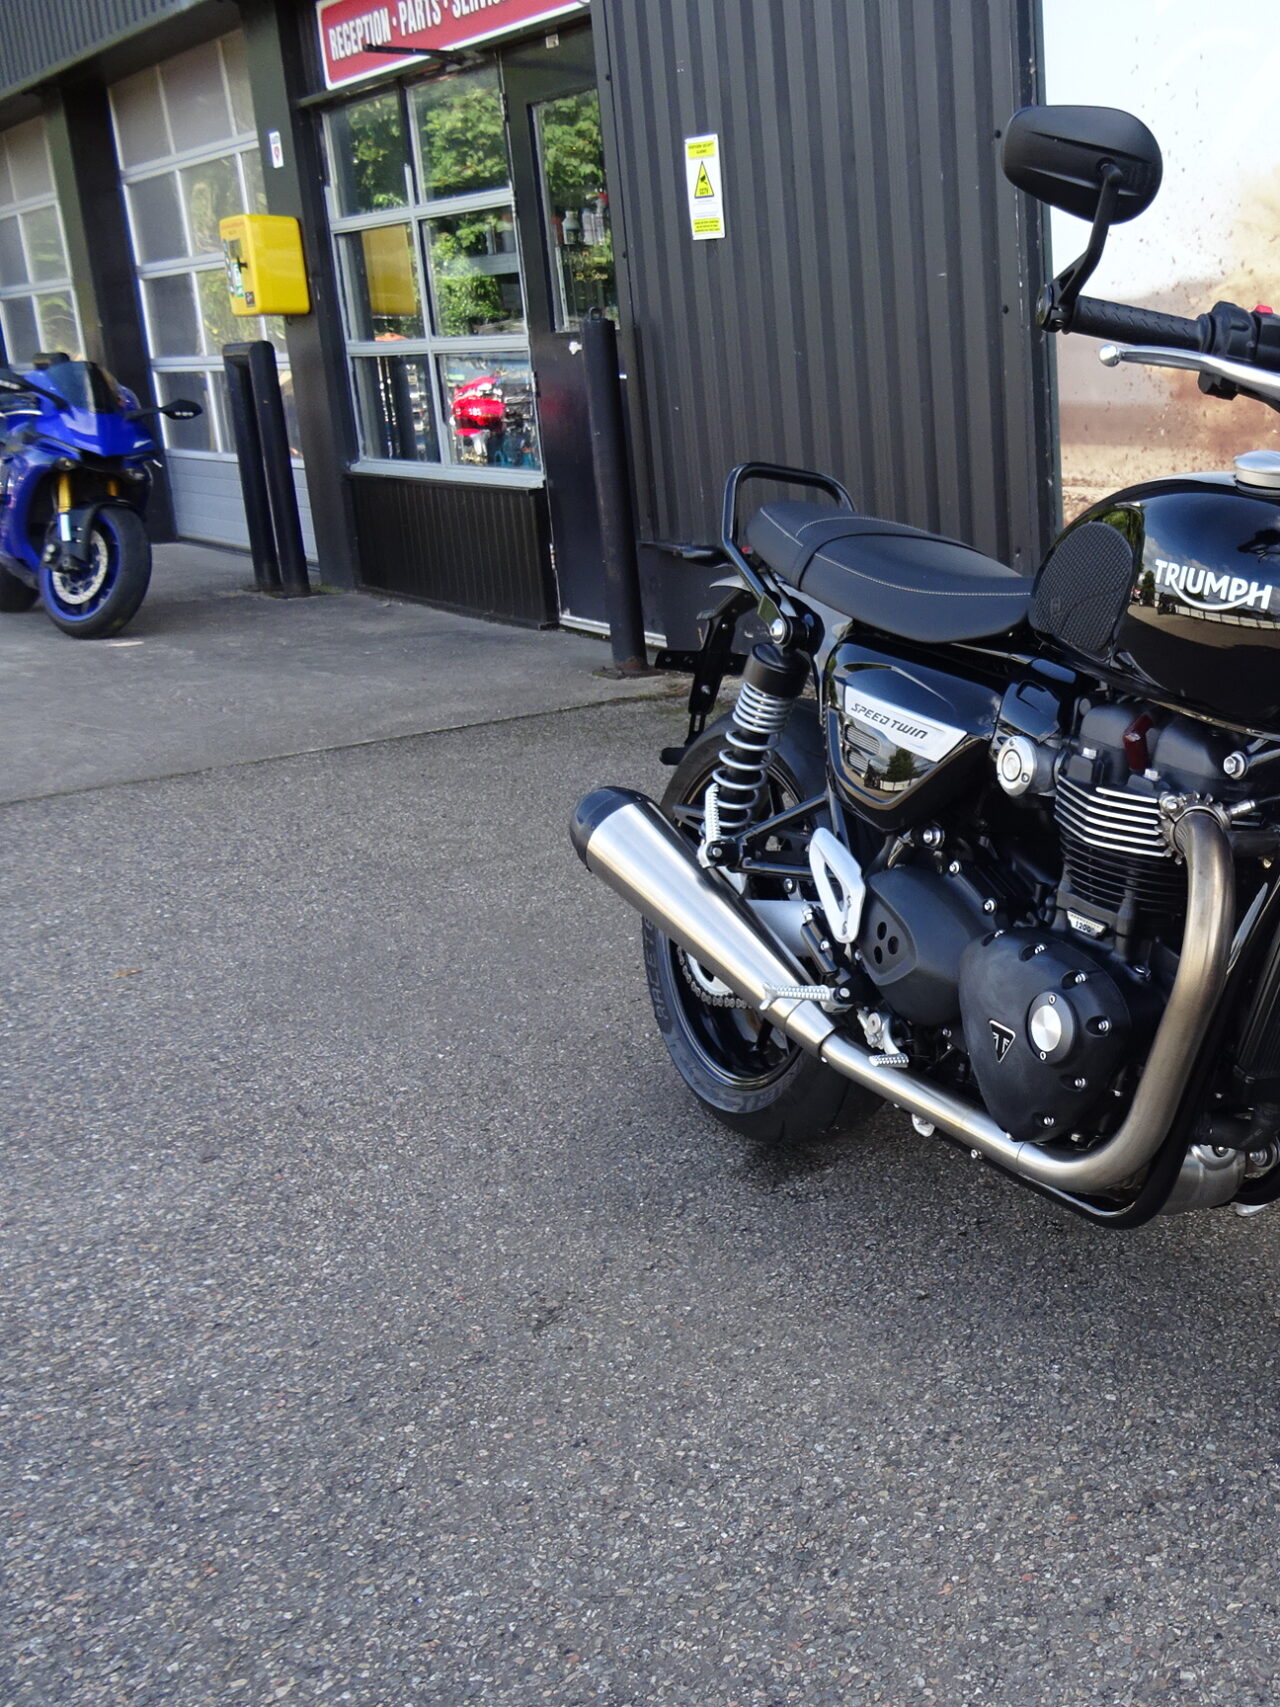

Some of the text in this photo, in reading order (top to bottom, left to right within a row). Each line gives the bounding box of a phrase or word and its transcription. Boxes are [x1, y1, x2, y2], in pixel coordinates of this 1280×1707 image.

[328, 0, 442, 61] RECEPTION PARTS
[1155, 558, 1273, 611] TRIUMPH
[851, 702, 928, 740] SPEED TWIN
